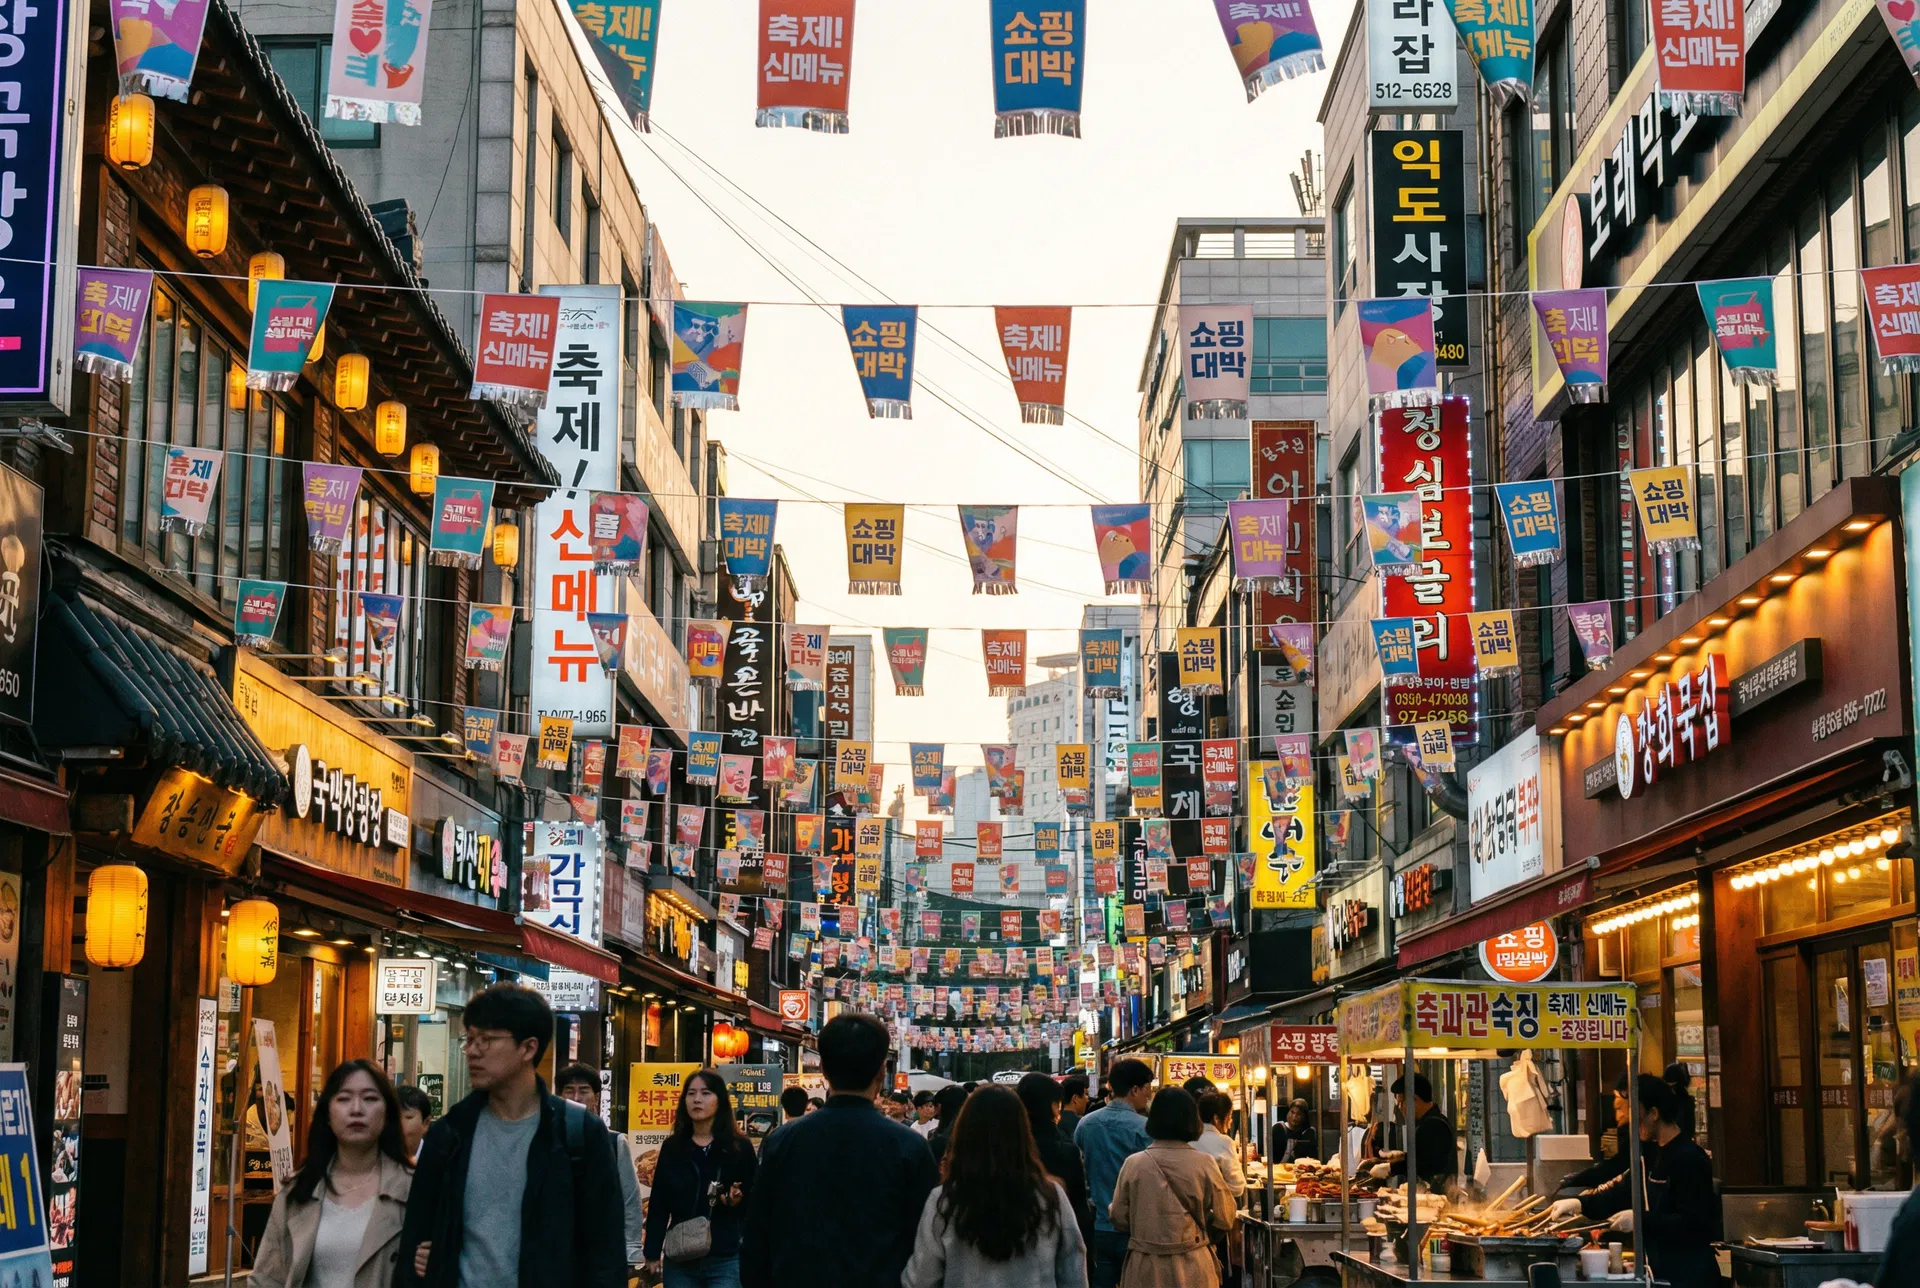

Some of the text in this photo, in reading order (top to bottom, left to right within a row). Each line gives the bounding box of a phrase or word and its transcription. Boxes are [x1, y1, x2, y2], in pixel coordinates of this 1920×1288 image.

[1229, 2, 1303, 20] 축제!
[1454, 0, 1529, 27] 축제!
[1661, 0, 1735, 31] 축제!
[767, 13, 842, 48] 축제!
[1003, 11, 1073, 46] 쇼핑
[1660, 37, 1740, 67] 신메뉴
[763, 52, 843, 84] 신메뉴
[1004, 50, 1075, 86] 대박
[1375, 82, 1452, 99] 512-6528
[489, 310, 548, 340] 축제!
[1544, 305, 1598, 336] 축제!
[852, 320, 906, 349] 쇼핑
[1003, 324, 1062, 352] 축제!
[1190, 320, 1244, 348] 쇼핑
[482, 340, 549, 371] 신메뉴
[1190, 351, 1246, 379] 대박
[552, 343, 603, 501] 축제!
[1643, 479, 1685, 502] 쇼핑
[1508, 491, 1552, 516] 쇼핑
[1646, 501, 1690, 525] 대박
[852, 518, 896, 540] 쇼핑
[1238, 515, 1281, 537] 축제
[1512, 513, 1556, 538] 대박
[724, 537, 768, 561] 대박
[852, 543, 896, 566] 대박
[548, 508, 599, 683] 신메뉴
[1478, 620, 1509, 638] 쇼핑
[1183, 638, 1215, 655] 쇼핑
[1479, 637, 1512, 655] 대박
[1183, 656, 1216, 673] 대박
[1548, 992, 1580, 1016] 축제!
[1586, 992, 1627, 1016] 신메뉴
[1276, 1032, 1306, 1053] 쇼핑
[652, 1072, 680, 1087] 축제!
